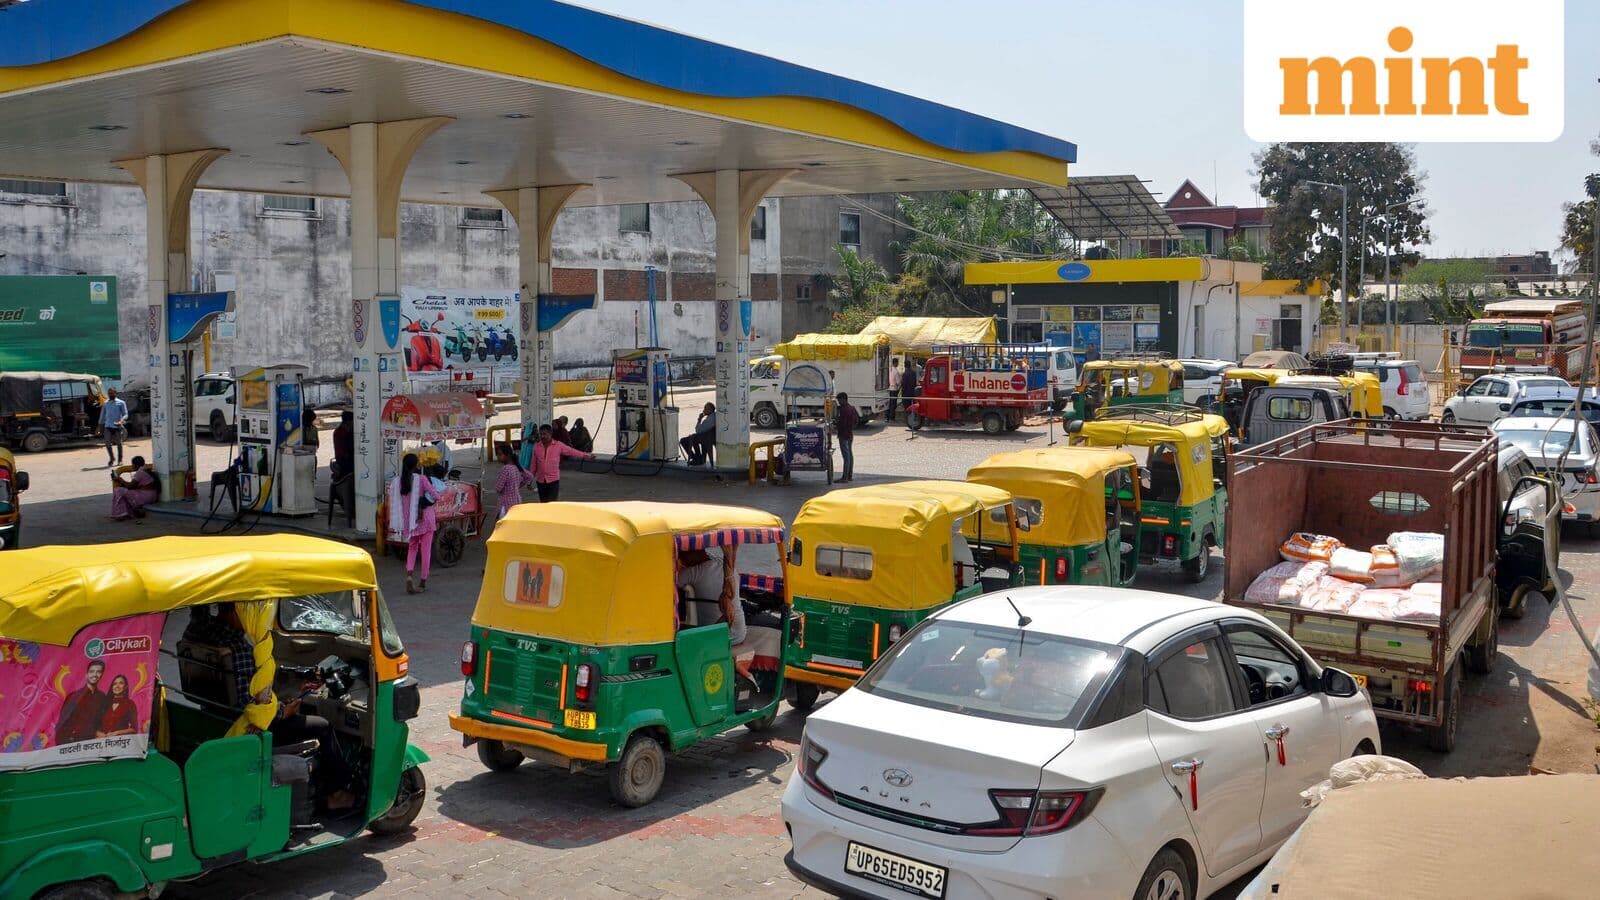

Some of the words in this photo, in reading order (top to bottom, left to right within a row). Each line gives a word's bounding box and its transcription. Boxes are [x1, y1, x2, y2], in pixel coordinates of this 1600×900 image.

[39, 305, 56, 320] को
[968, 372, 1010, 390] Indane
[830, 605, 850, 615] TVS
[106, 637, 146, 652] Citykart
[516, 639, 538, 652] TVS
[860, 785, 932, 809] AURA
[856, 850, 943, 892] UP65ED5952
